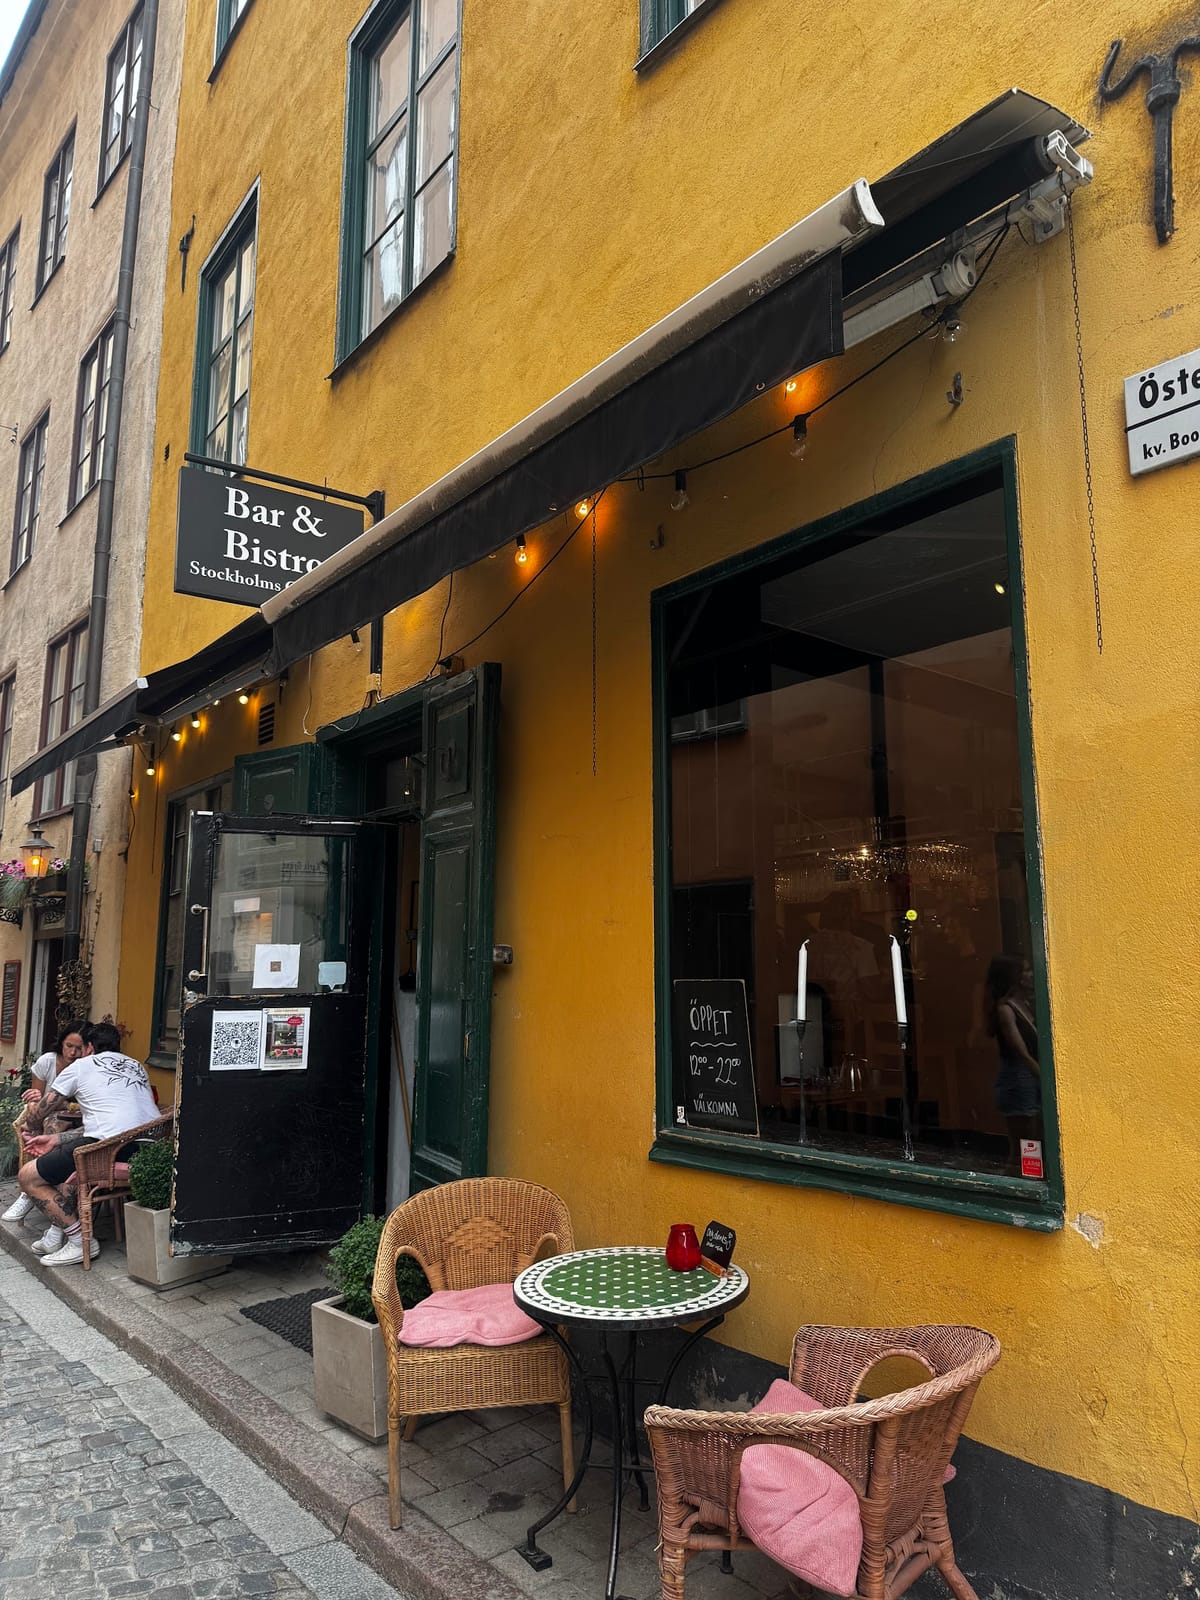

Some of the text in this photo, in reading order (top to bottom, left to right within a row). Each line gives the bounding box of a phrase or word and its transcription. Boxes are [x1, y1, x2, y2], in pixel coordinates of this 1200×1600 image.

[1142, 430, 1199, 460] kv. Boo
[224, 486, 327, 538] Bar &
[223, 528, 322, 574] Bistro
[189, 560, 281, 592] Stockholms
[689, 998, 733, 1036] ÖPPET
[693, 1093, 739, 1118] VÄLKOMNA
